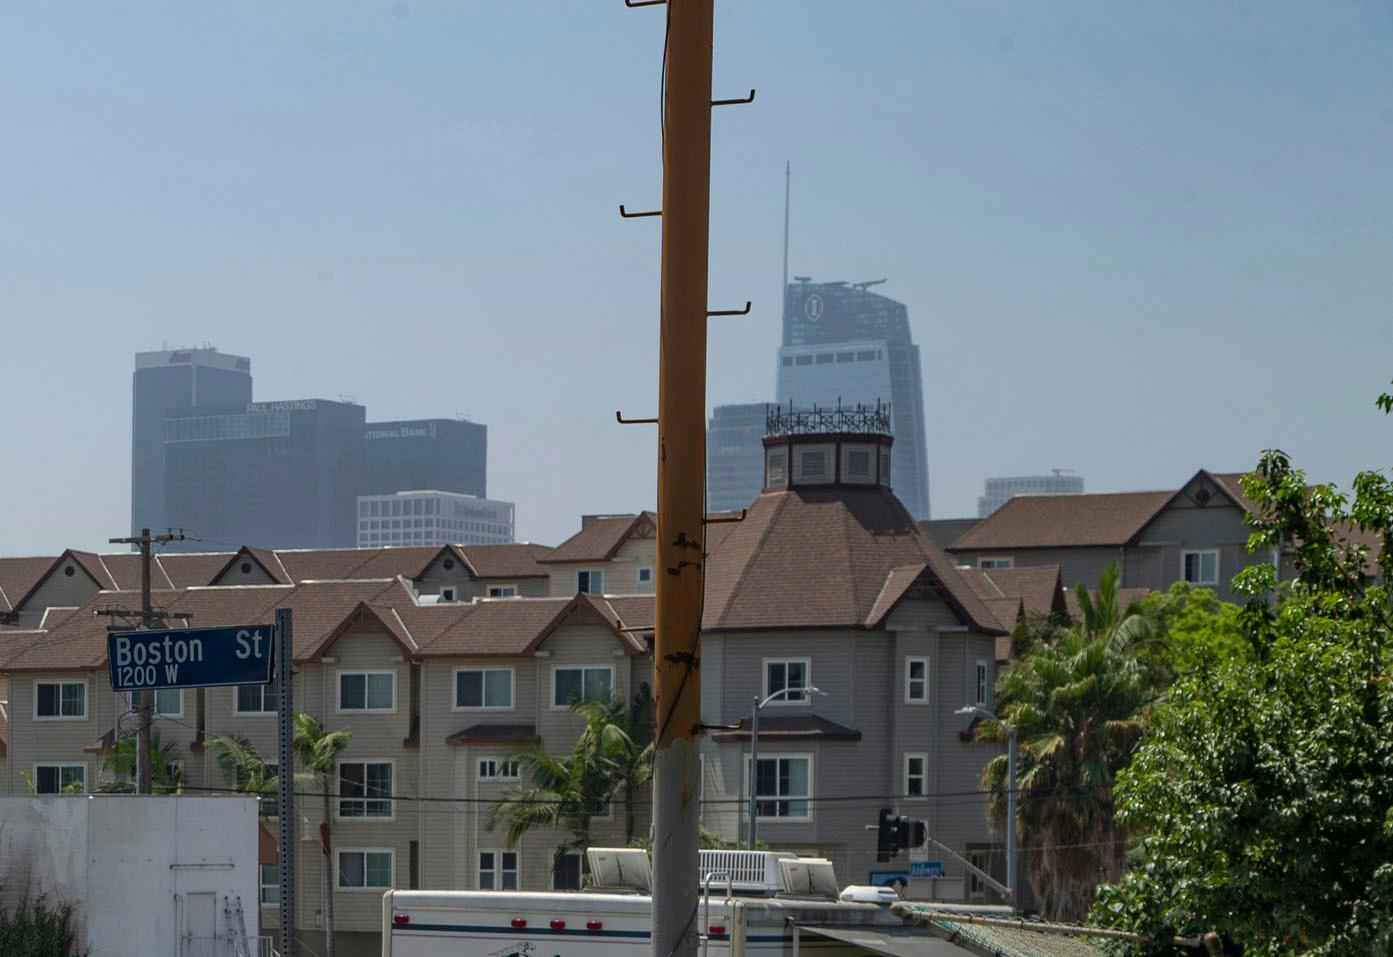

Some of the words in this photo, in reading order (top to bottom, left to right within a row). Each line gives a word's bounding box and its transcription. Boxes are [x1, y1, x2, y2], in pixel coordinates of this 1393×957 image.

[116, 635, 203, 667] Boston
[235, 630, 263, 659] St
[117, 665, 156, 687] 1200
[165, 664, 179, 684] W
